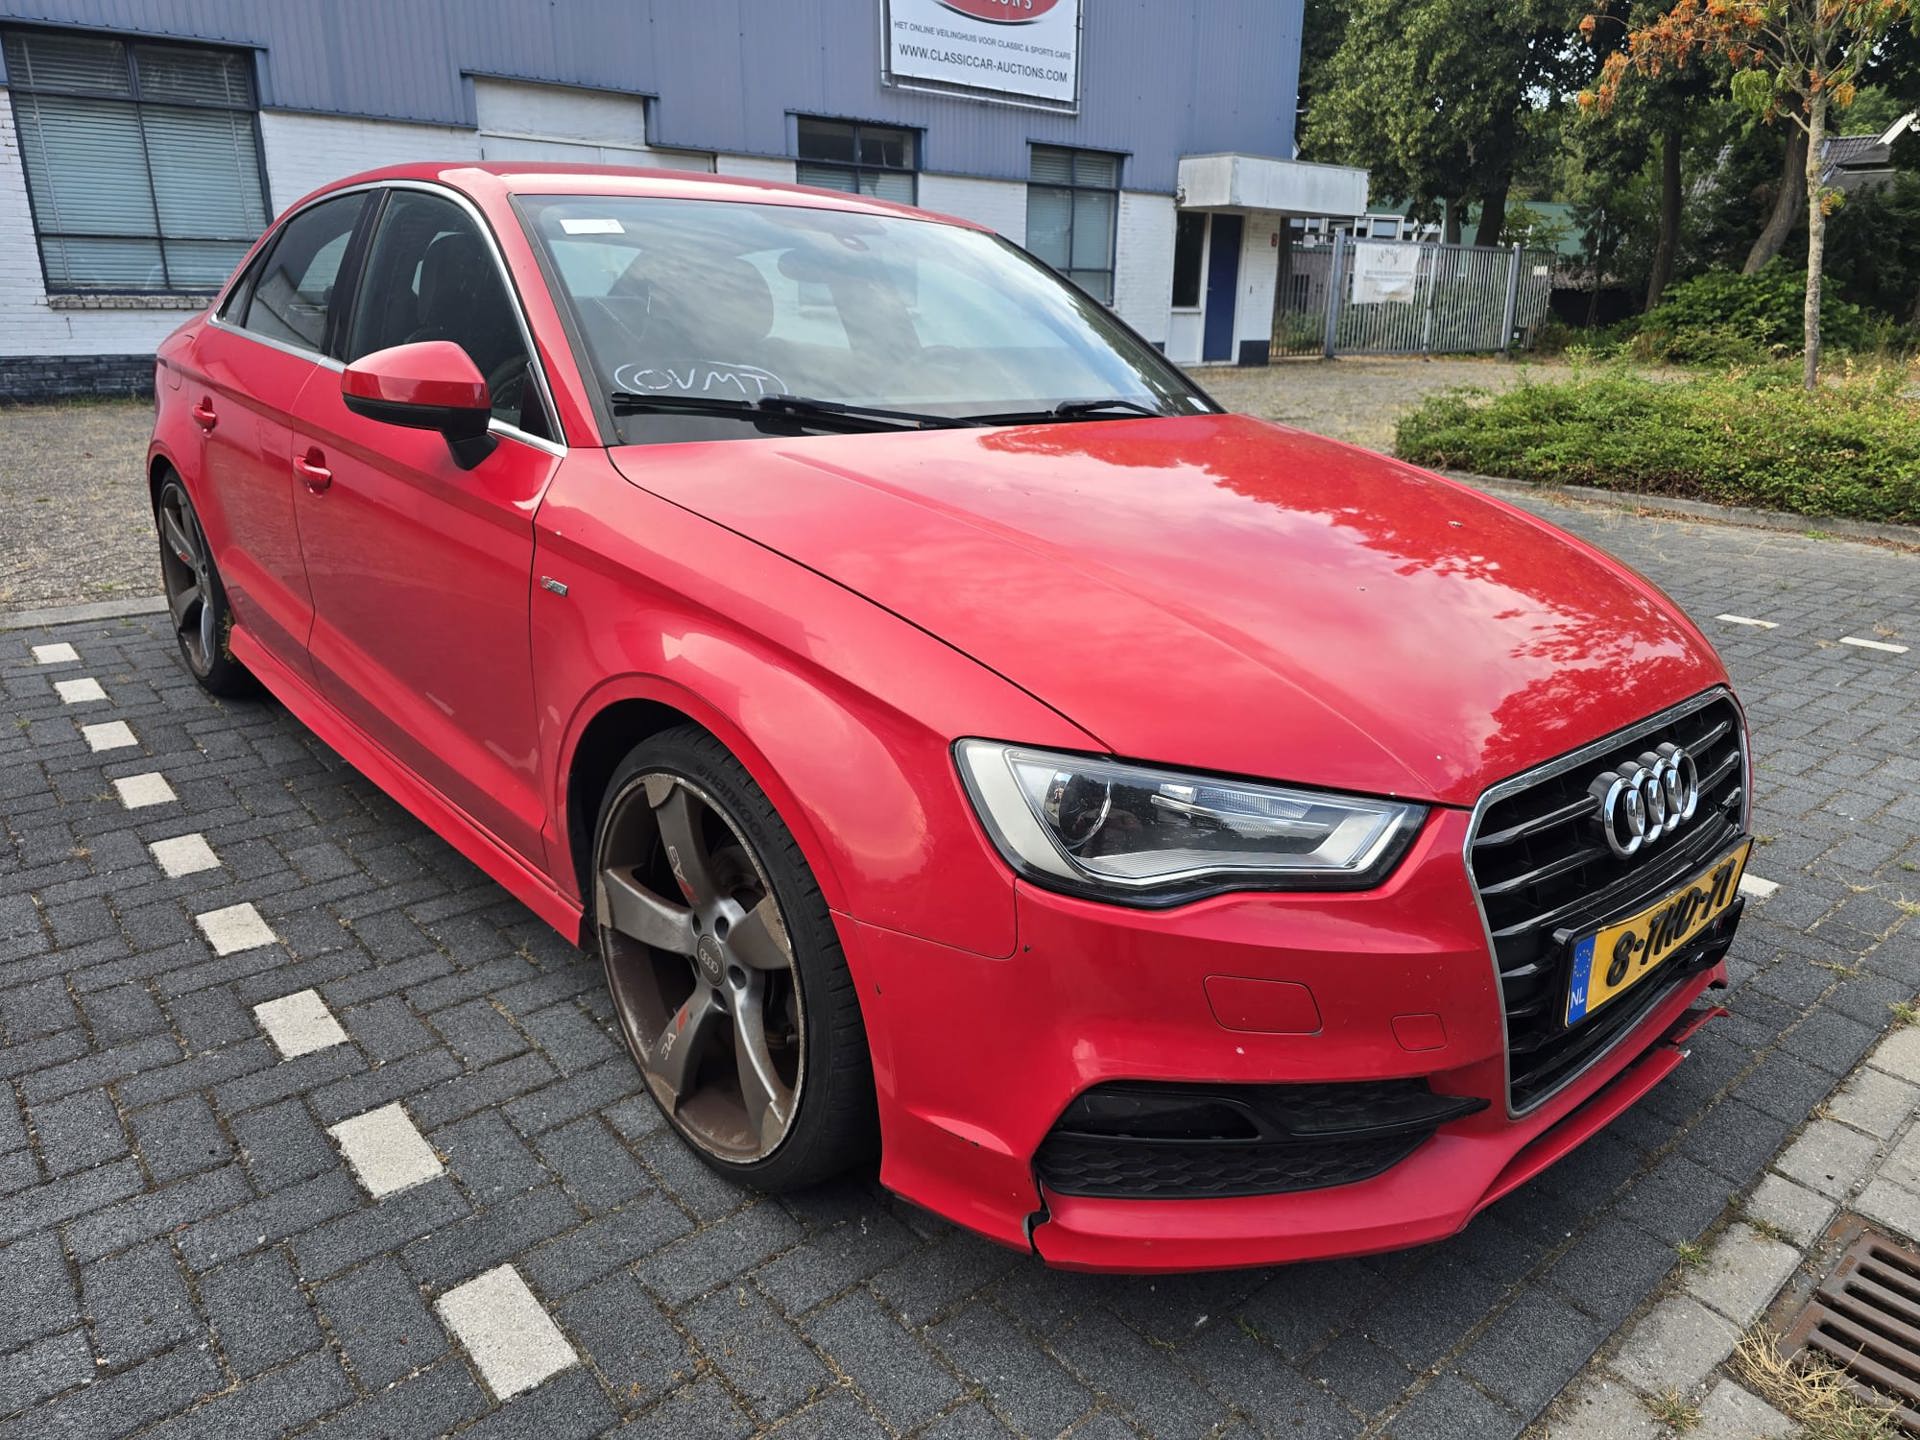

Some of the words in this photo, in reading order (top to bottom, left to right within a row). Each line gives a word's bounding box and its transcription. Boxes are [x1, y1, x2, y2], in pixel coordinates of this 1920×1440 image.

[894, 21, 908, 31] HET
[909, 23, 935, 36] ONLINE
[936, 28, 977, 43] VEILINGHUIS
[978, 36, 997, 47] VOOR
[997, 39, 1024, 52] CLASSIC
[1030, 45, 1054, 58] SPORTS
[1055, 50, 1072, 60] CARS
[899, 43, 1068, 82] WWW.CLASSICCAR-AUCTIONS.COM
[1570, 987, 1585, 1008] NL
